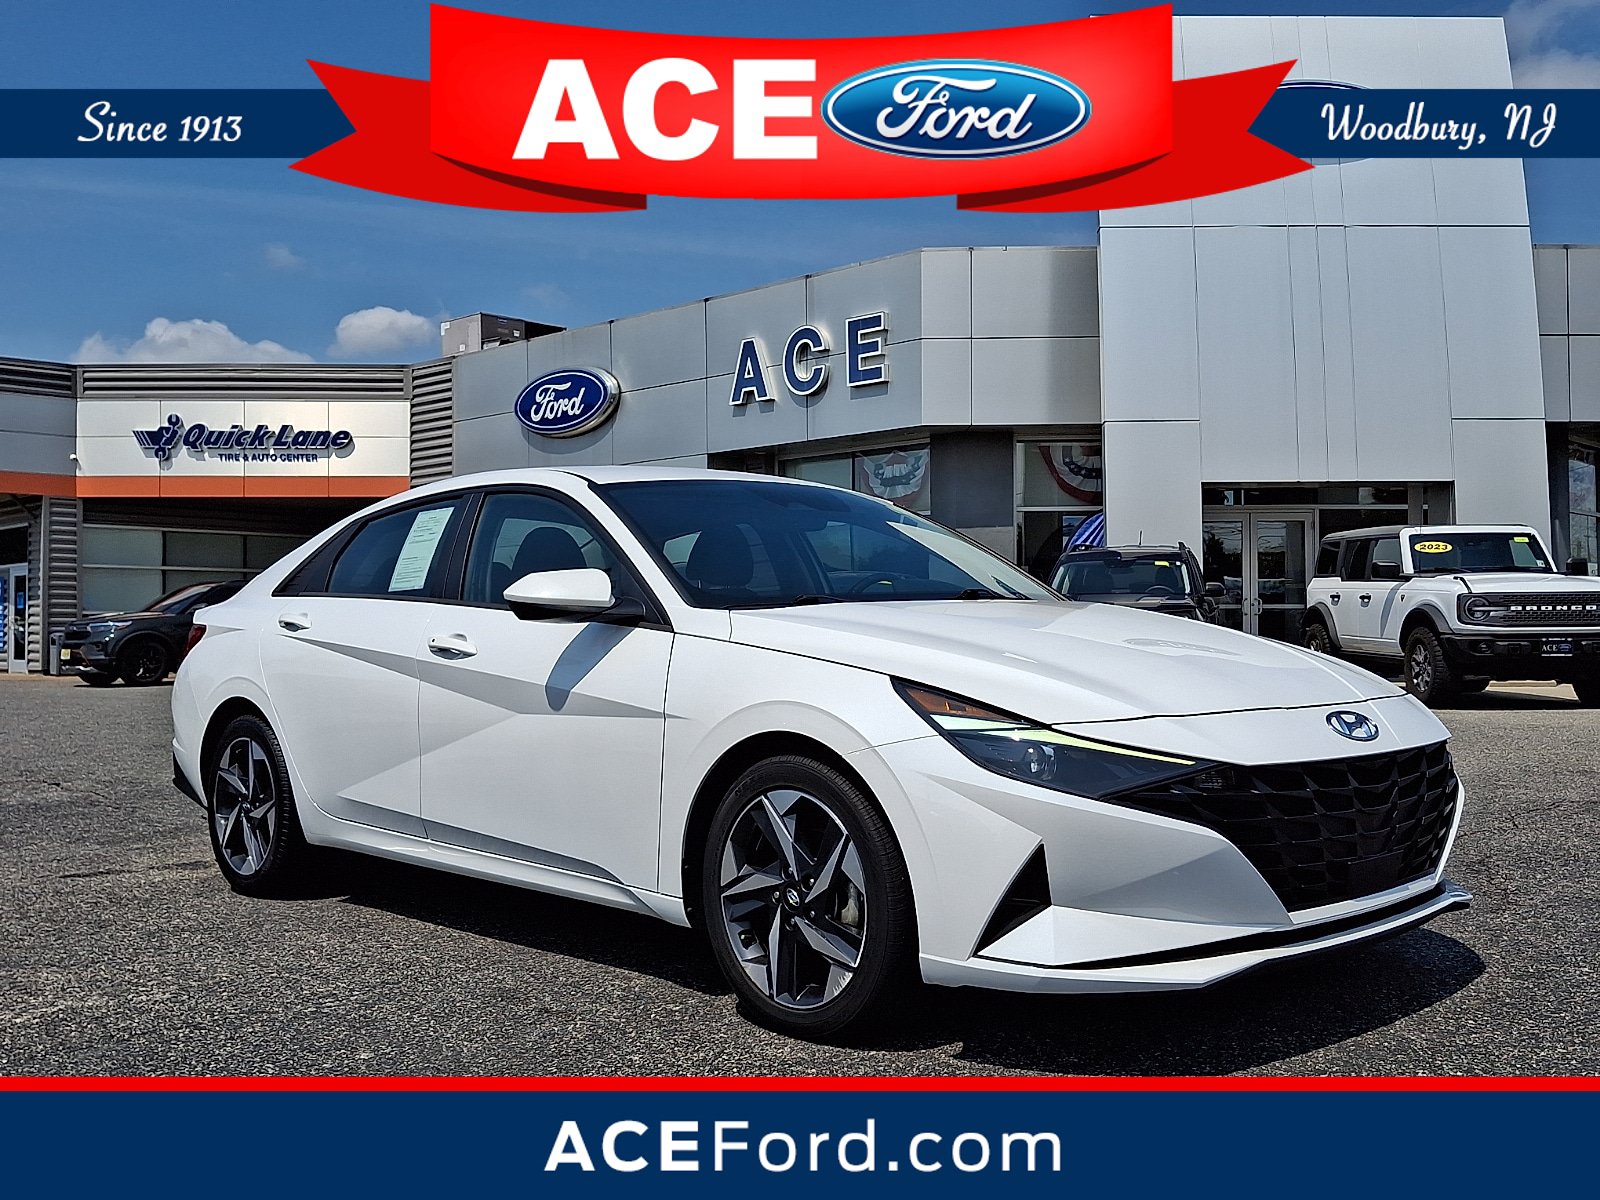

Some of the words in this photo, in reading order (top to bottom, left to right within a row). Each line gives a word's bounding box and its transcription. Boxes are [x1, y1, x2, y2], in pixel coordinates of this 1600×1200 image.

[729, 311, 888, 407] ACE
[529, 381, 585, 421] Ford
[182, 423, 270, 450] Quick
[272, 424, 353, 449] Lane
[218, 453, 241, 462] TIRE
[243, 453, 250, 462] &
[251, 453, 278, 462] AUTO
[280, 453, 318, 462] CENTER
[1541, 644, 1558, 652] ACE
